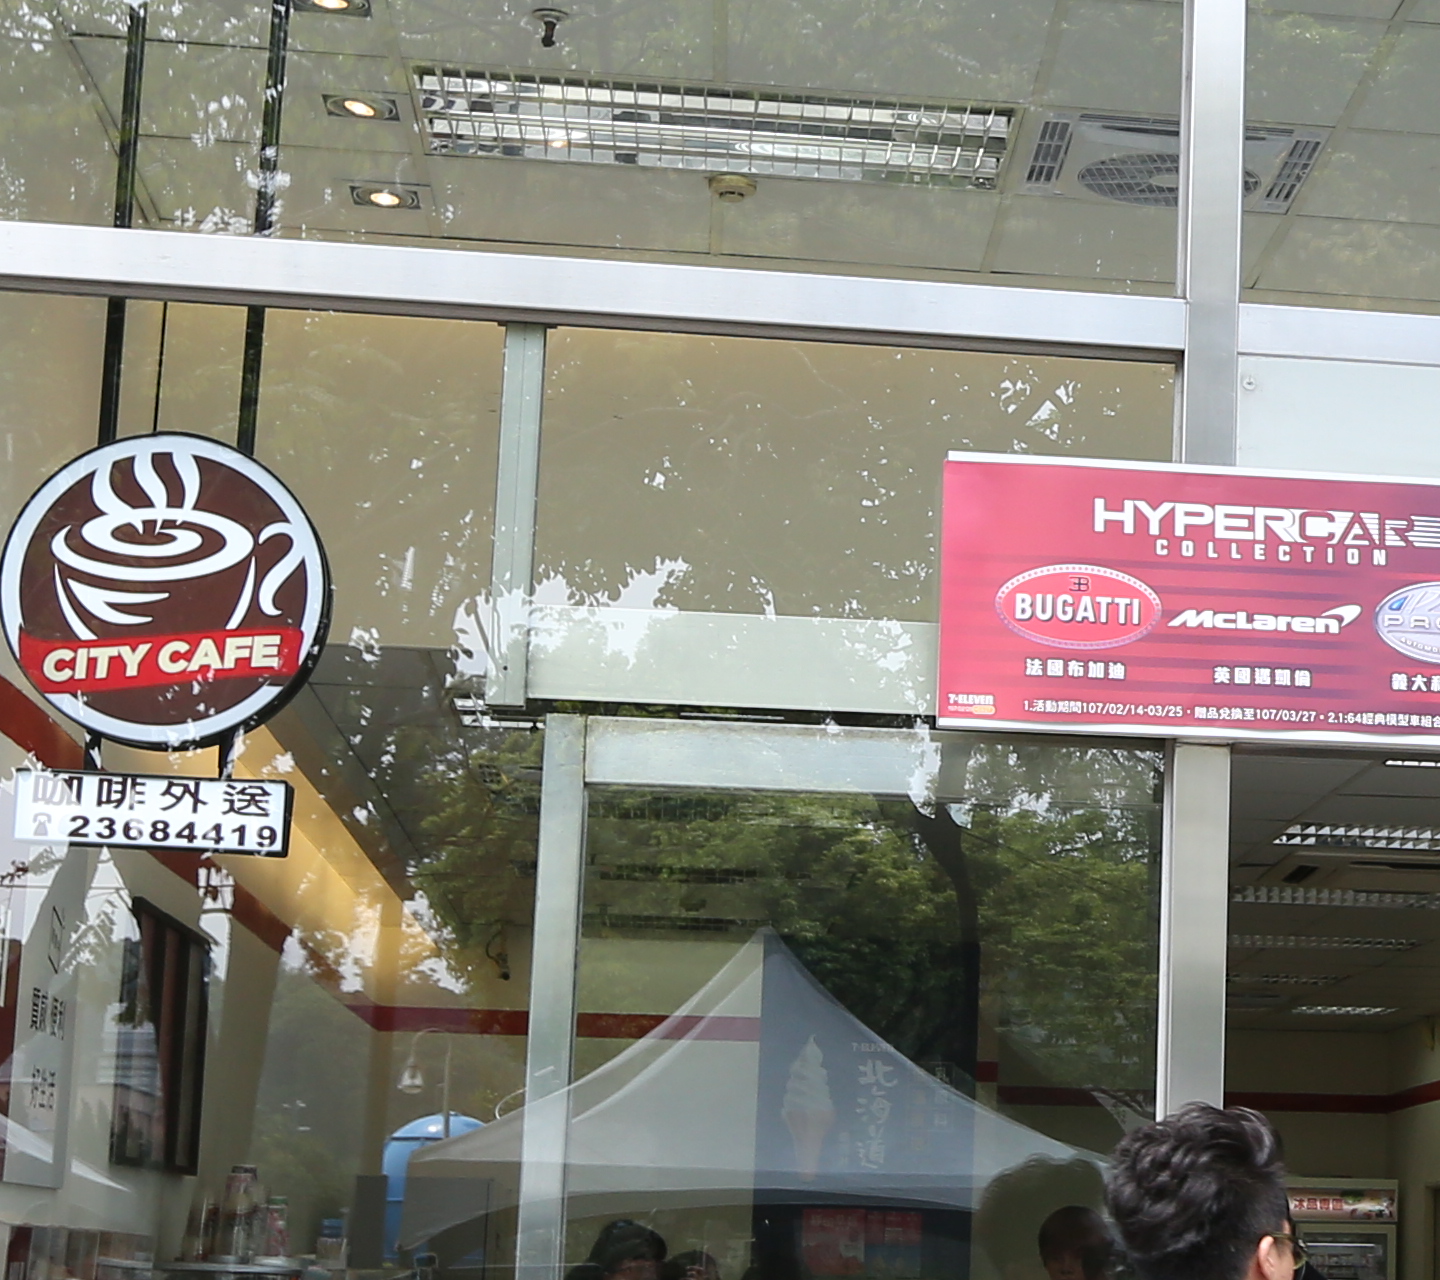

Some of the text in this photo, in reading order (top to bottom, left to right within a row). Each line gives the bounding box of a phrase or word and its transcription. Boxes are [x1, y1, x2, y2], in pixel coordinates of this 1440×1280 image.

[1093, 497, 1417, 549] HYPERCAR
[1155, 538, 1390, 567] COLLECTION
[1013, 592, 1142, 628] BUGATTI
[1166, 606, 1362, 635] McLaren
[42, 634, 281, 682] CITY CAFE
[1025, 657, 1127, 681] 法國布加迪
[1212, 665, 1313, 688] 英國邁凱倫
[31, 775, 274, 818] 咖啡外送
[67, 814, 278, 848] 23684419
